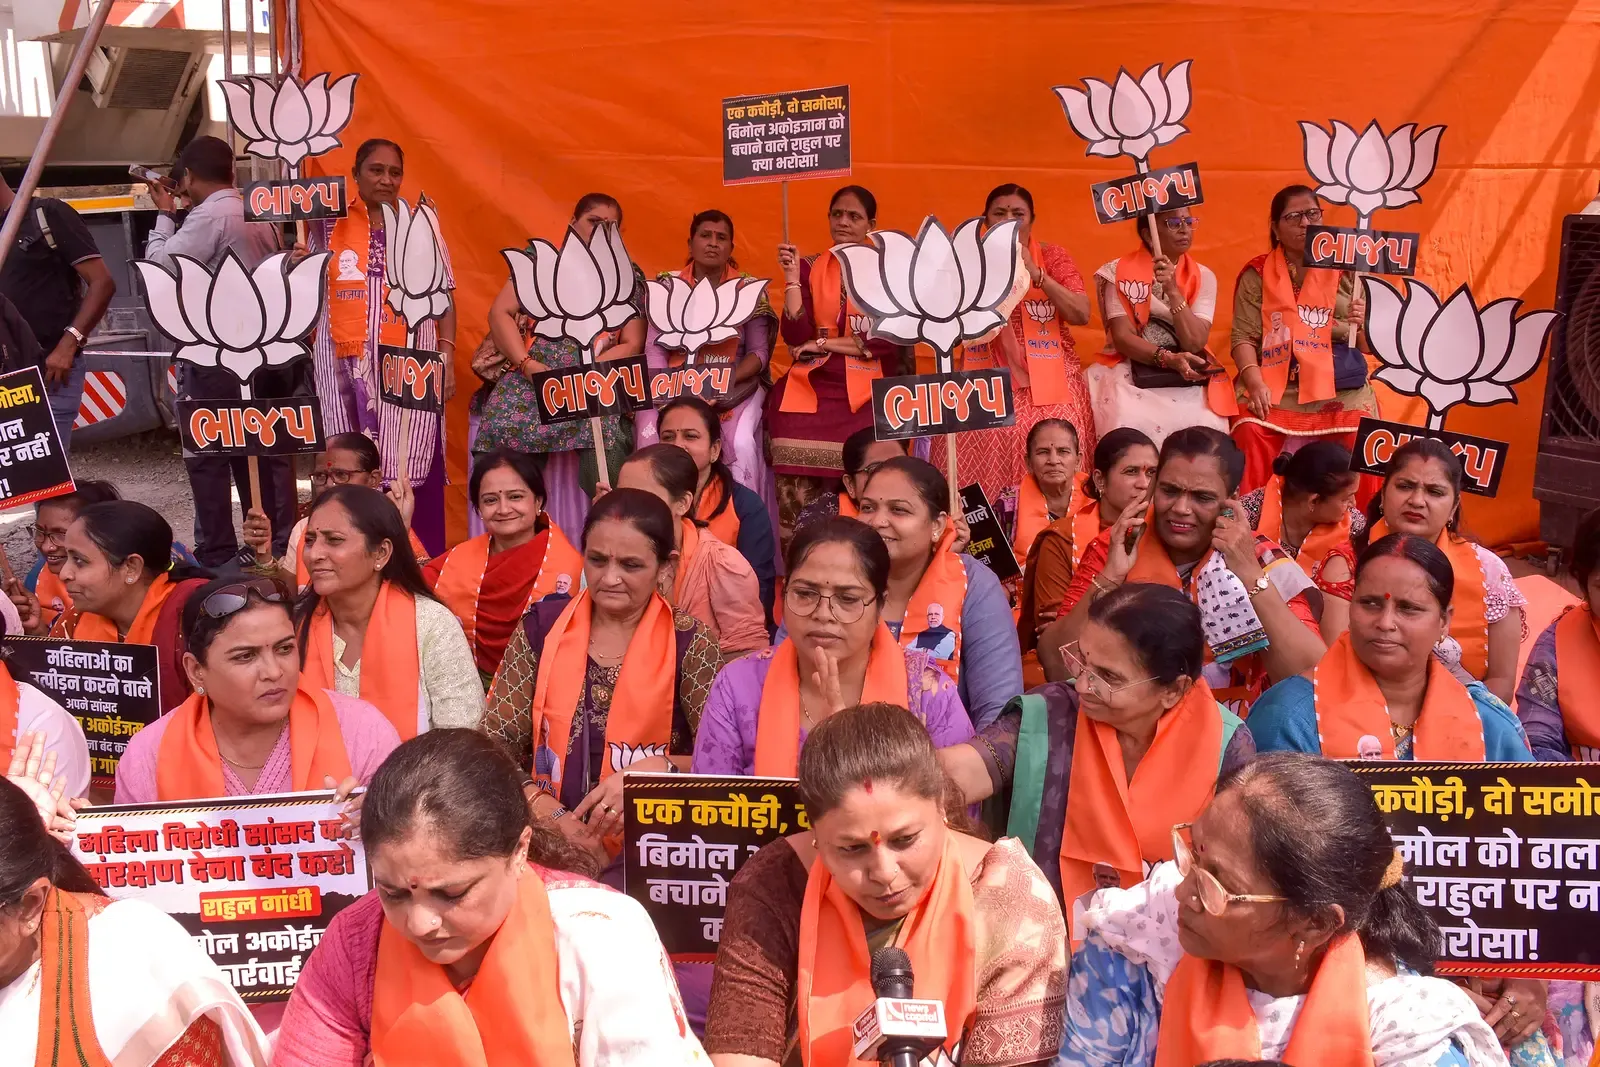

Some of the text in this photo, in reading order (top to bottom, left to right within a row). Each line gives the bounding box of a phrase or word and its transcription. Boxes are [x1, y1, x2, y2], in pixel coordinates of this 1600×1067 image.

[726, 94, 846, 120] एक कचौड़ी, दो समोसा,
[727, 112, 846, 140] बिमोल अकोइजाम को
[731, 134, 841, 156] बचाने वाले राहुल पर
[752, 152, 819, 172] क्या भरोसा!
[250, 182, 340, 216] ભાજપ
[1102, 169, 1197, 218] ભાજપ
[1311, 231, 1412, 269] ભાજપ
[543, 363, 646, 416] ભાજપ
[650, 367, 731, 399] ભાજપ
[884, 376, 1007, 430] ભાજપ
[190, 405, 317, 449] ભાજપ
[12, 431, 51, 462] नहीं
[46, 646, 133, 673] महिलाओं का
[82, 674, 120, 696] करने
[121, 676, 152, 698] वाले
[66, 696, 118, 714] अपने सांसद
[99, 738, 113, 752] बंद
[633, 798, 685, 825] एक
[689, 793, 788, 836] कचौड़ी,
[1371, 776, 1600, 822] कचौड़ी, दो समो
[77, 825, 159, 855] महिला
[161, 819, 239, 852] विरोधी
[243, 816, 315, 846] सांसद
[636, 832, 739, 870] बिमोल
[1474, 828, 1522, 868] को
[1528, 837, 1600, 870] ढाल
[187, 851, 245, 883] देना
[250, 847, 293, 880] बंद
[298, 842, 356, 876] करो
[201, 888, 313, 920] राहुल गांधी
[646, 873, 730, 907] बचाने
[1413, 876, 1506, 917] राहुल
[1511, 879, 1561, 910] पर
